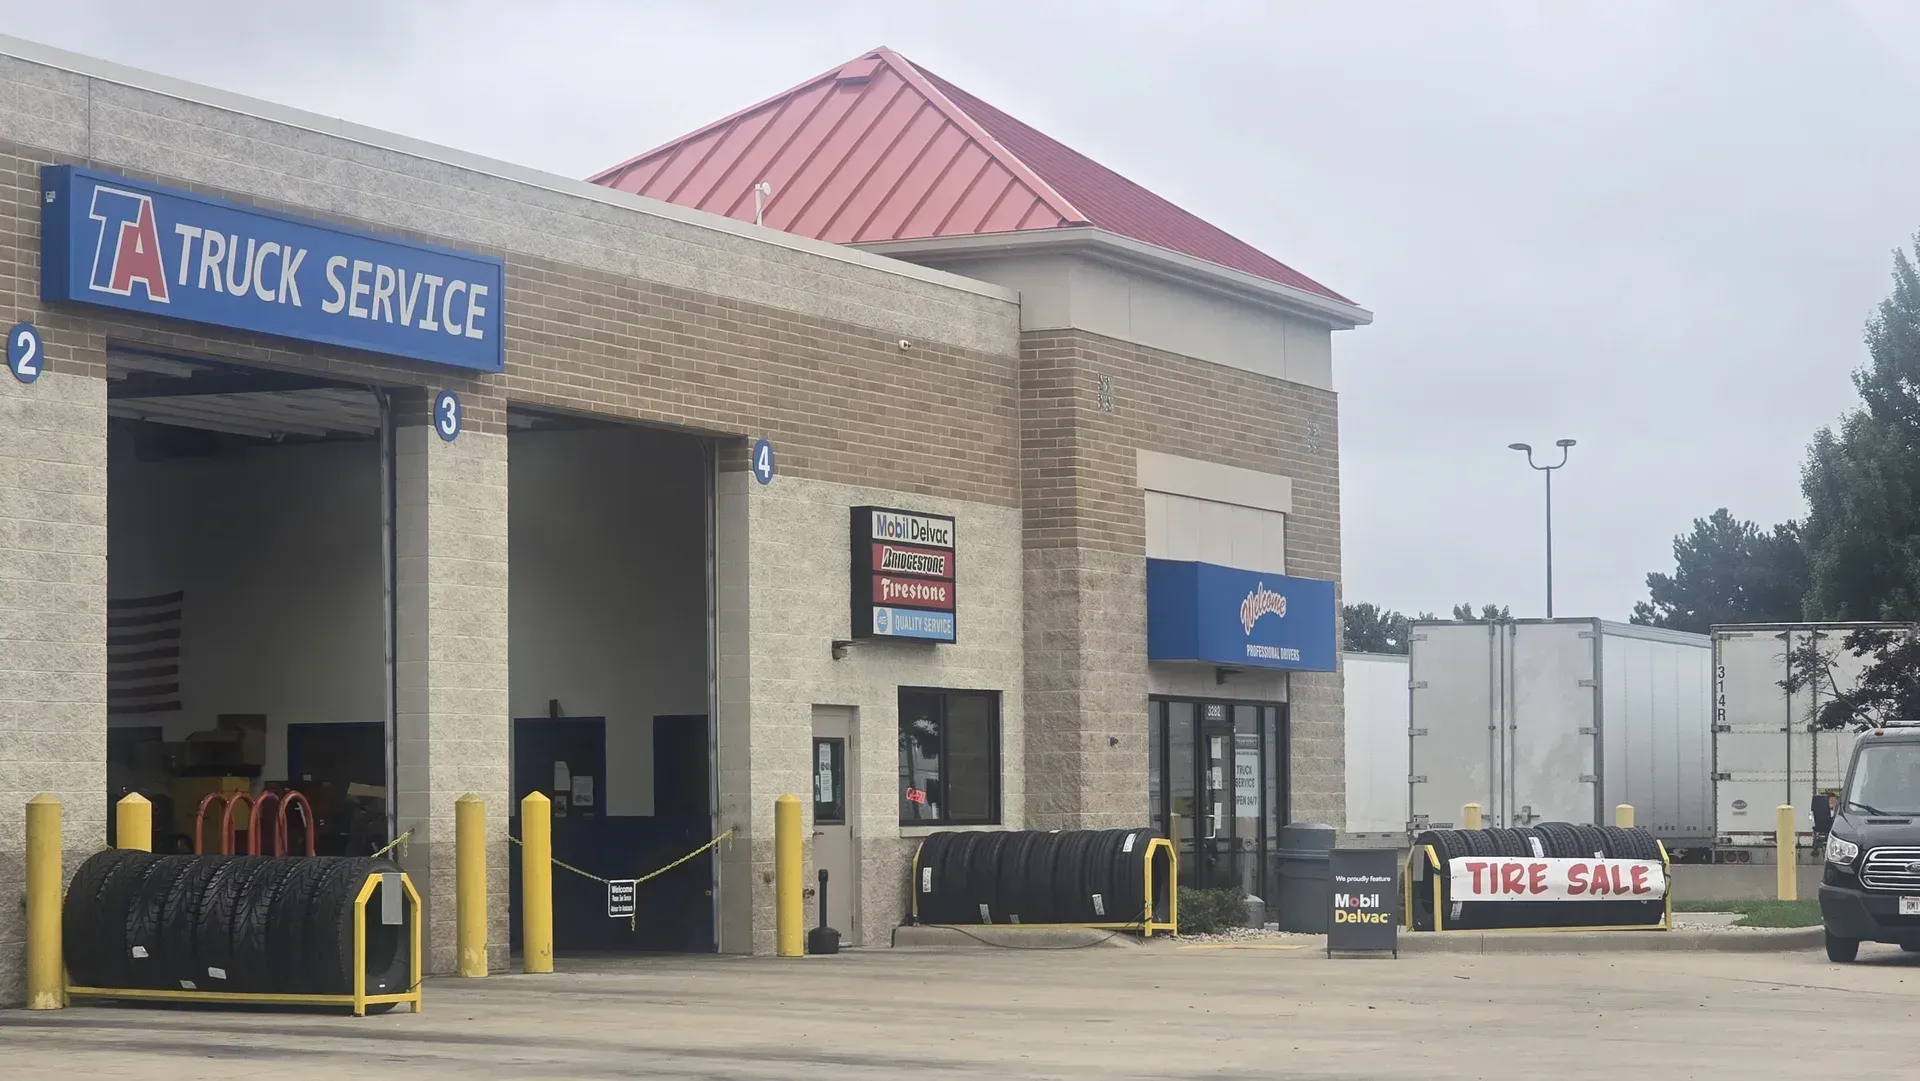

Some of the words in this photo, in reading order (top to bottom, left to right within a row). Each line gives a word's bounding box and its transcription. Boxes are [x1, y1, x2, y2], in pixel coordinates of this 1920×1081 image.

[88, 184, 170, 304] TA
[175, 223, 307, 307] TRUCK
[322, 255, 489, 340] SERVICE
[17, 331, 37, 375] 2
[441, 396, 457, 435] 3
[758, 445, 771, 478] 4
[876, 514, 909, 539] Mobil
[911, 518, 948, 545] Delvac
[882, 546, 944, 575] BRIDGESTONE
[881, 578, 946, 602] Firestone
[1240, 580, 1287, 636] Welcome
[895, 615, 922, 631] QUALITY
[923, 617, 951, 634] SERVICE
[1246, 644, 1280, 659] PROFESSIONAL
[1280, 647, 1300, 661] DRIVERS
[1207, 705, 1221, 717] 3282
[1236, 764, 1253, 775] TRUCK
[1235, 778, 1255, 788] SERVICE
[1346, 875, 1369, 884] proudly
[1465, 862, 1548, 895] TIRE
[1567, 862, 1652, 895] SALE
[1334, 893, 1379, 908] Mobil
[1335, 909, 1388, 924] Delvac
